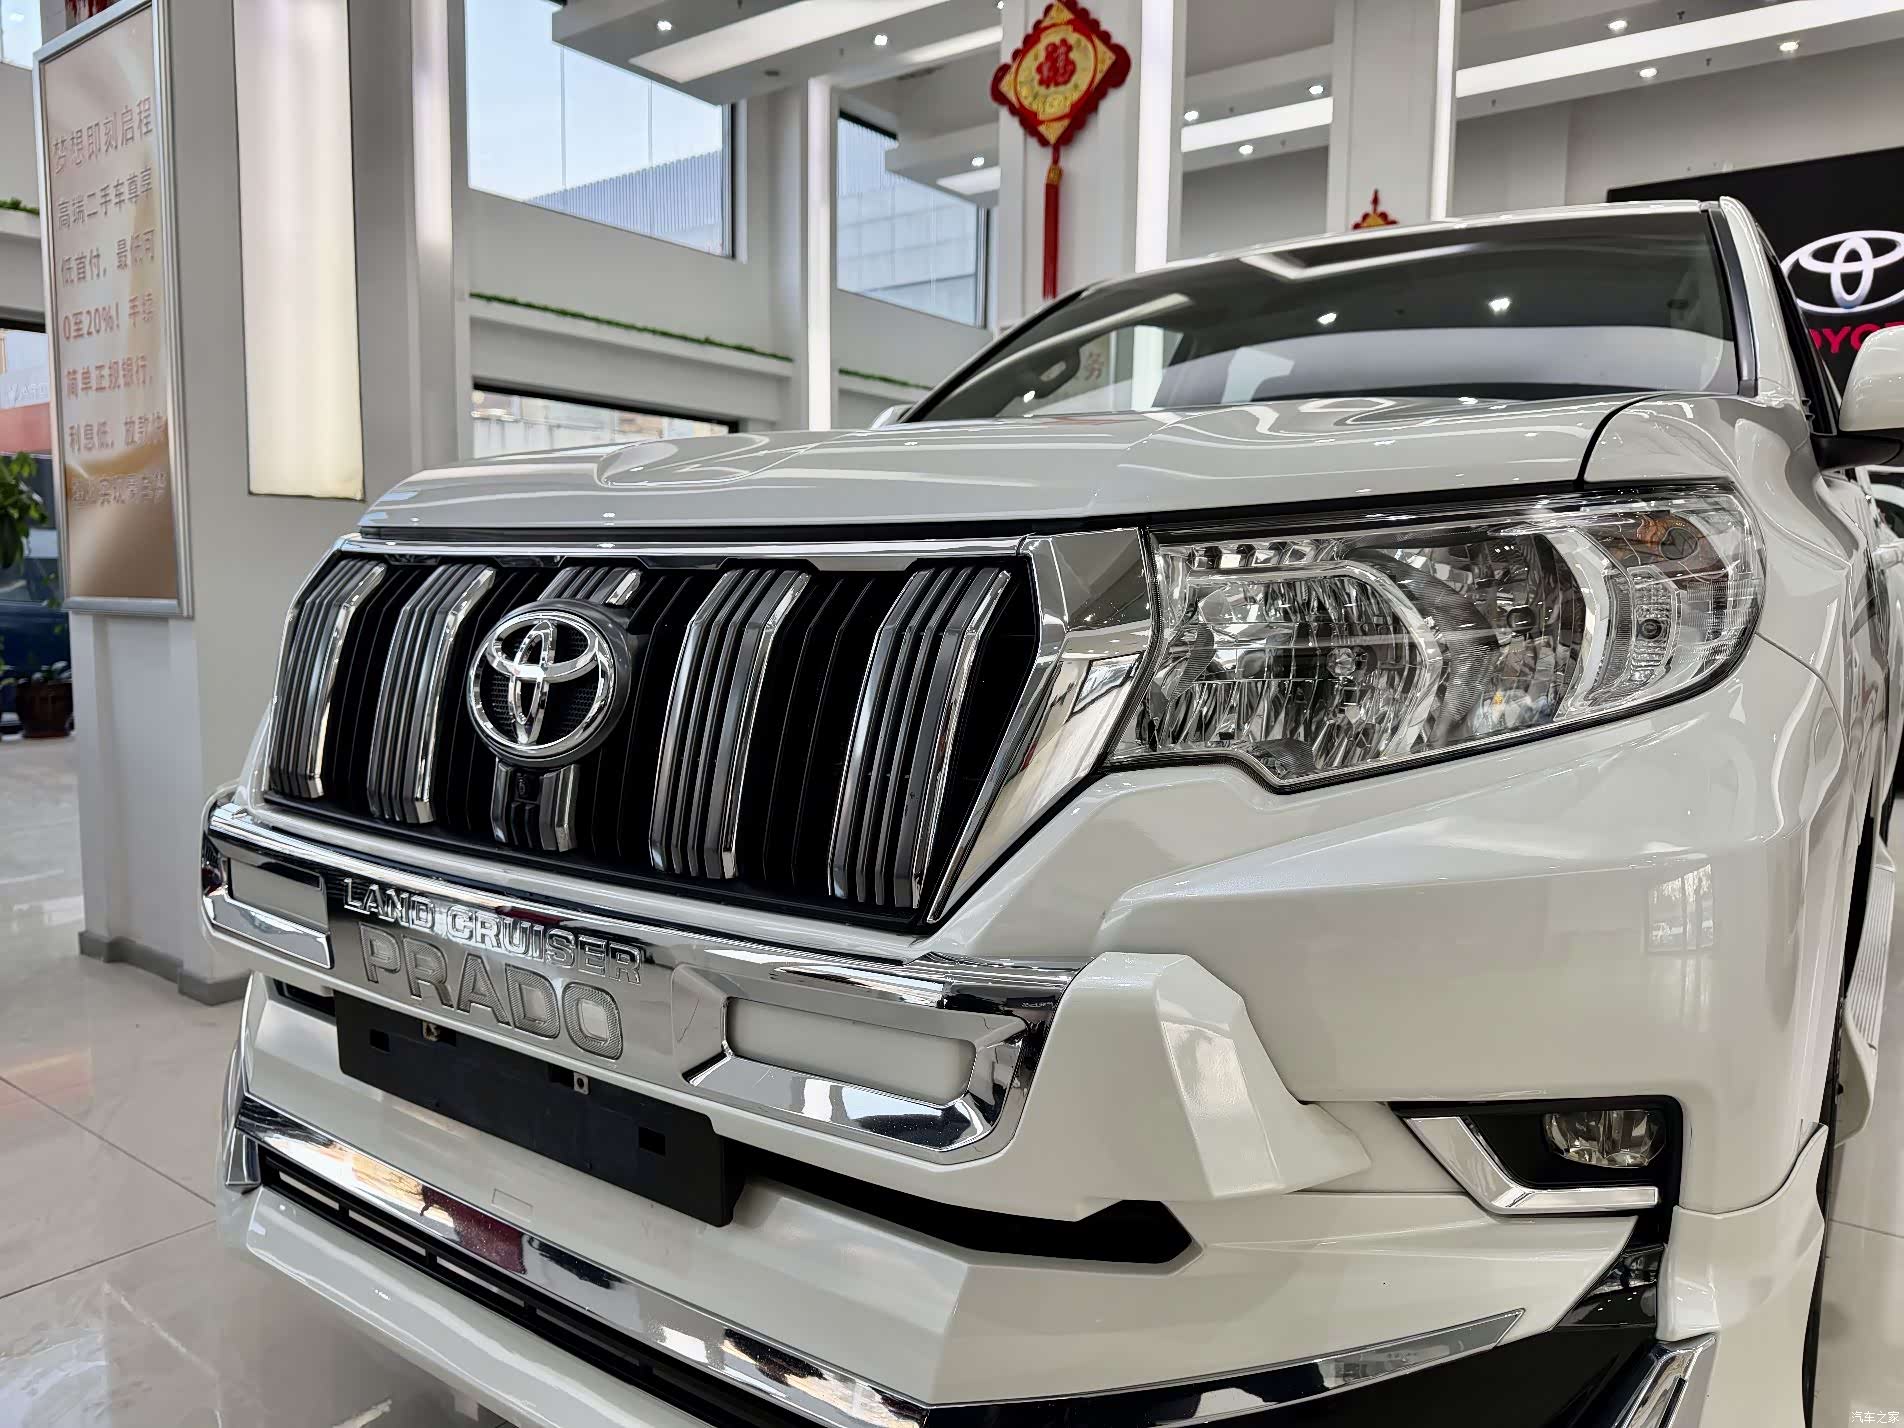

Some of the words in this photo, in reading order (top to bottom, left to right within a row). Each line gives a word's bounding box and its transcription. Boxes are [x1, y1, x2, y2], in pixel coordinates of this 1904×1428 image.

[53, 96, 152, 175] 梦想即刻启程
[58, 165, 152, 231] 高端二手车尊享
[343, 877, 435, 932] LAND
[446, 903, 645, 985] CRUISER
[358, 922, 624, 1061] PRADO
